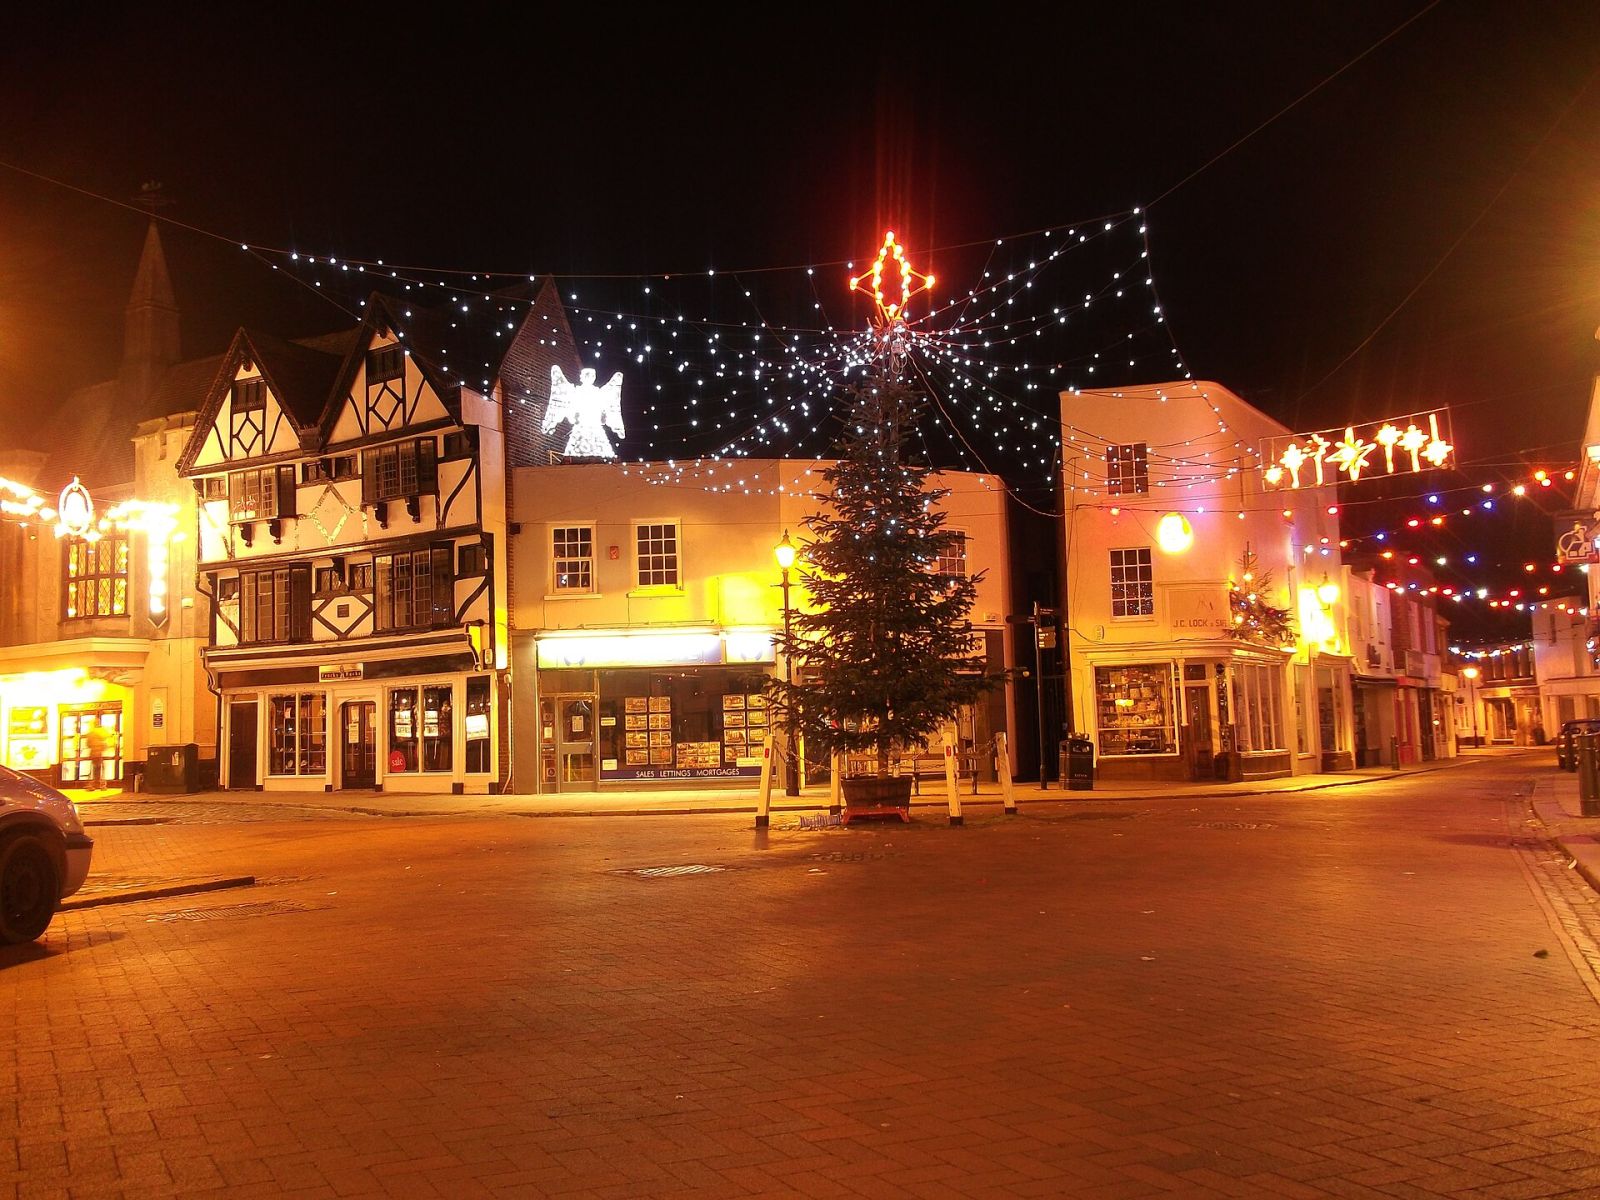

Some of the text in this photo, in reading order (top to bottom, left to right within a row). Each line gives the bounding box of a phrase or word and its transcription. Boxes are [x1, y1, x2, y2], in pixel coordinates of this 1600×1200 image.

[1189, 618, 1208, 628] LOCK
[391, 757, 403, 766] sale
[636, 768, 740, 778] SALES LETTINGS MORTGAGES
